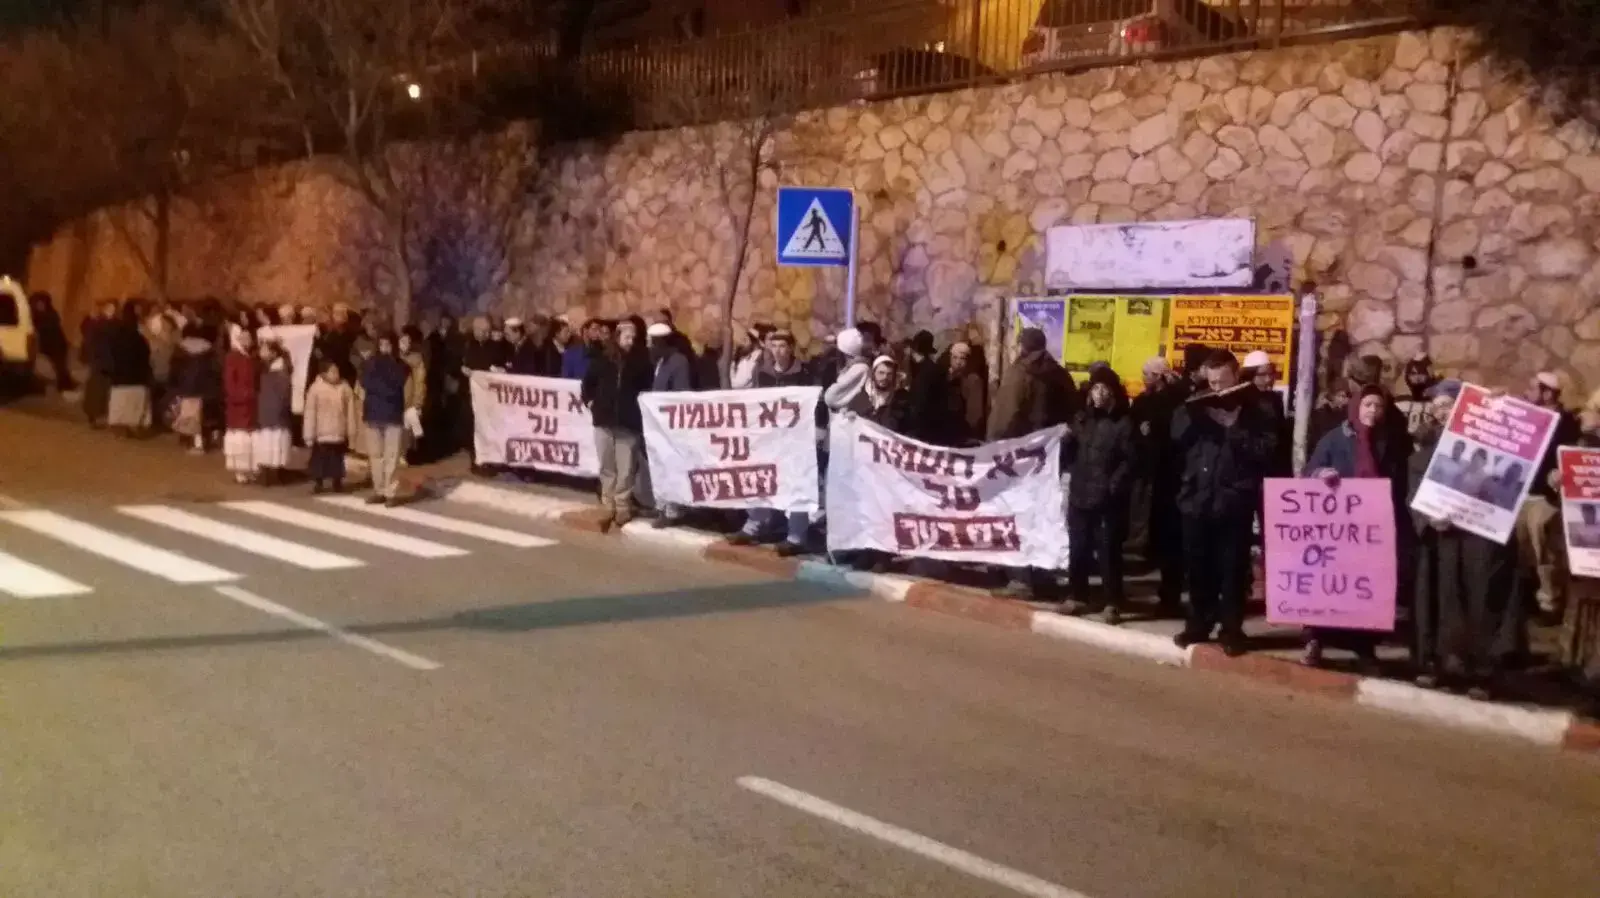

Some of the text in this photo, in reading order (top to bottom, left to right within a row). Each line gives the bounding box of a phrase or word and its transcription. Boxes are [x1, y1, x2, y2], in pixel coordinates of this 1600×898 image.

[1240, 328, 1282, 342] בבא
[488, 383, 584, 414] א תעמוד
[659, 397, 801, 430] לא תעמוד
[528, 412, 559, 435] על
[710, 433, 750, 462] על
[858, 434, 1047, 480] לא תעמוד
[691, 471, 735, 501] רעך
[922, 478, 981, 511] על
[1280, 489, 1363, 515] STOP
[898, 518, 961, 549] רעך
[1274, 522, 1383, 545] TORTURE
[1302, 544, 1338, 568] OF
[1277, 570, 1374, 600] JEWS
